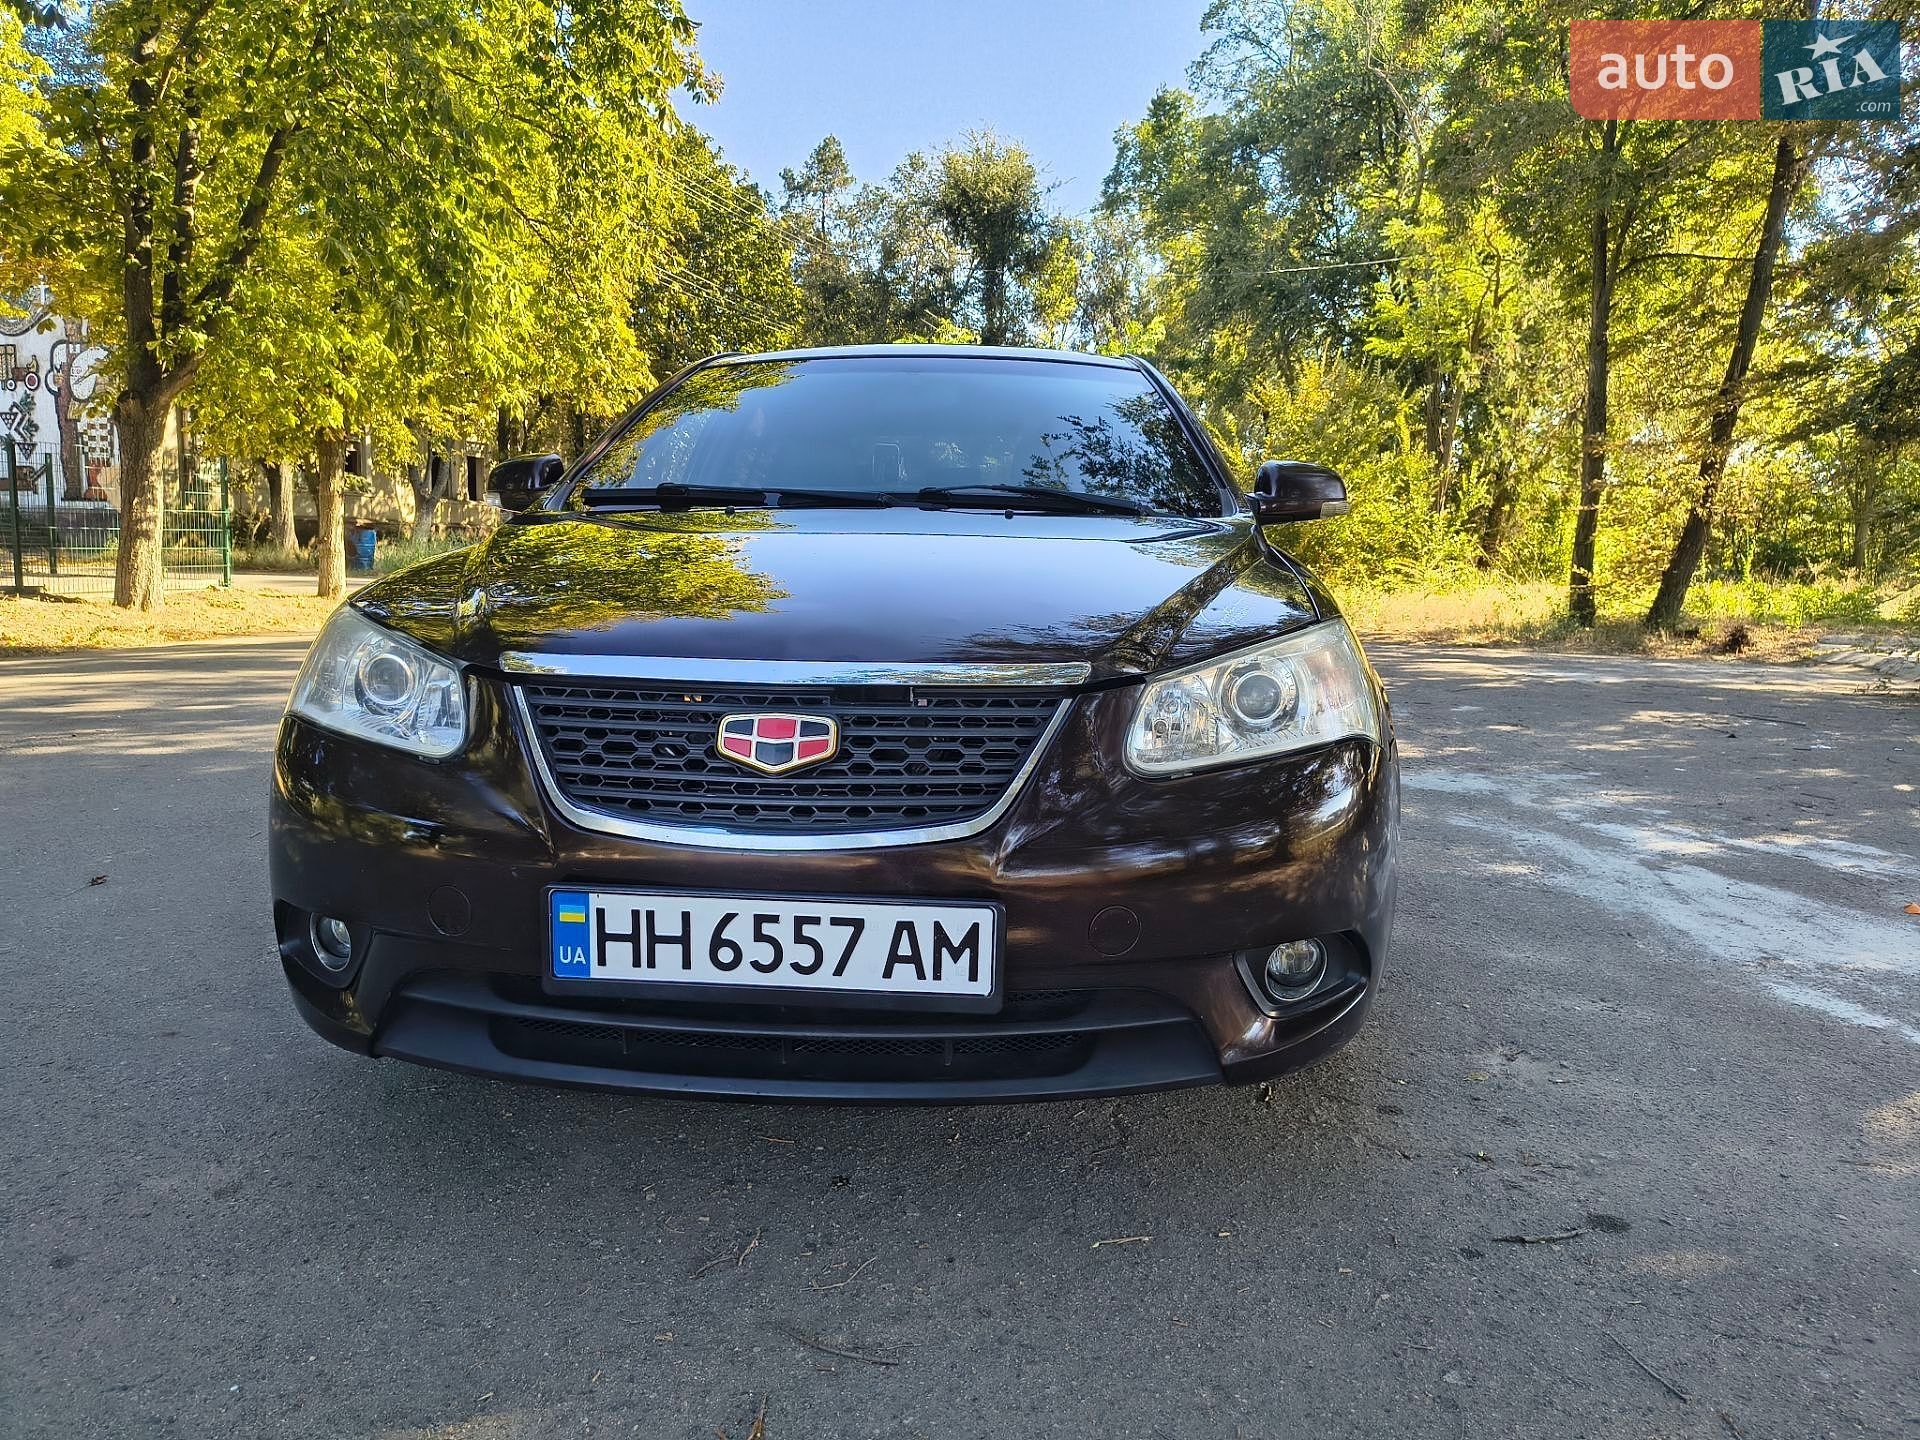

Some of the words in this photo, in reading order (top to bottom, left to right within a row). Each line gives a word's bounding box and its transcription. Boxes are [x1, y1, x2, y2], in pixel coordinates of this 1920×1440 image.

[559, 945, 587, 965] UA
[595, 907, 692, 970] HH
[708, 912, 866, 977] 6557
[881, 920, 980, 982] AM
